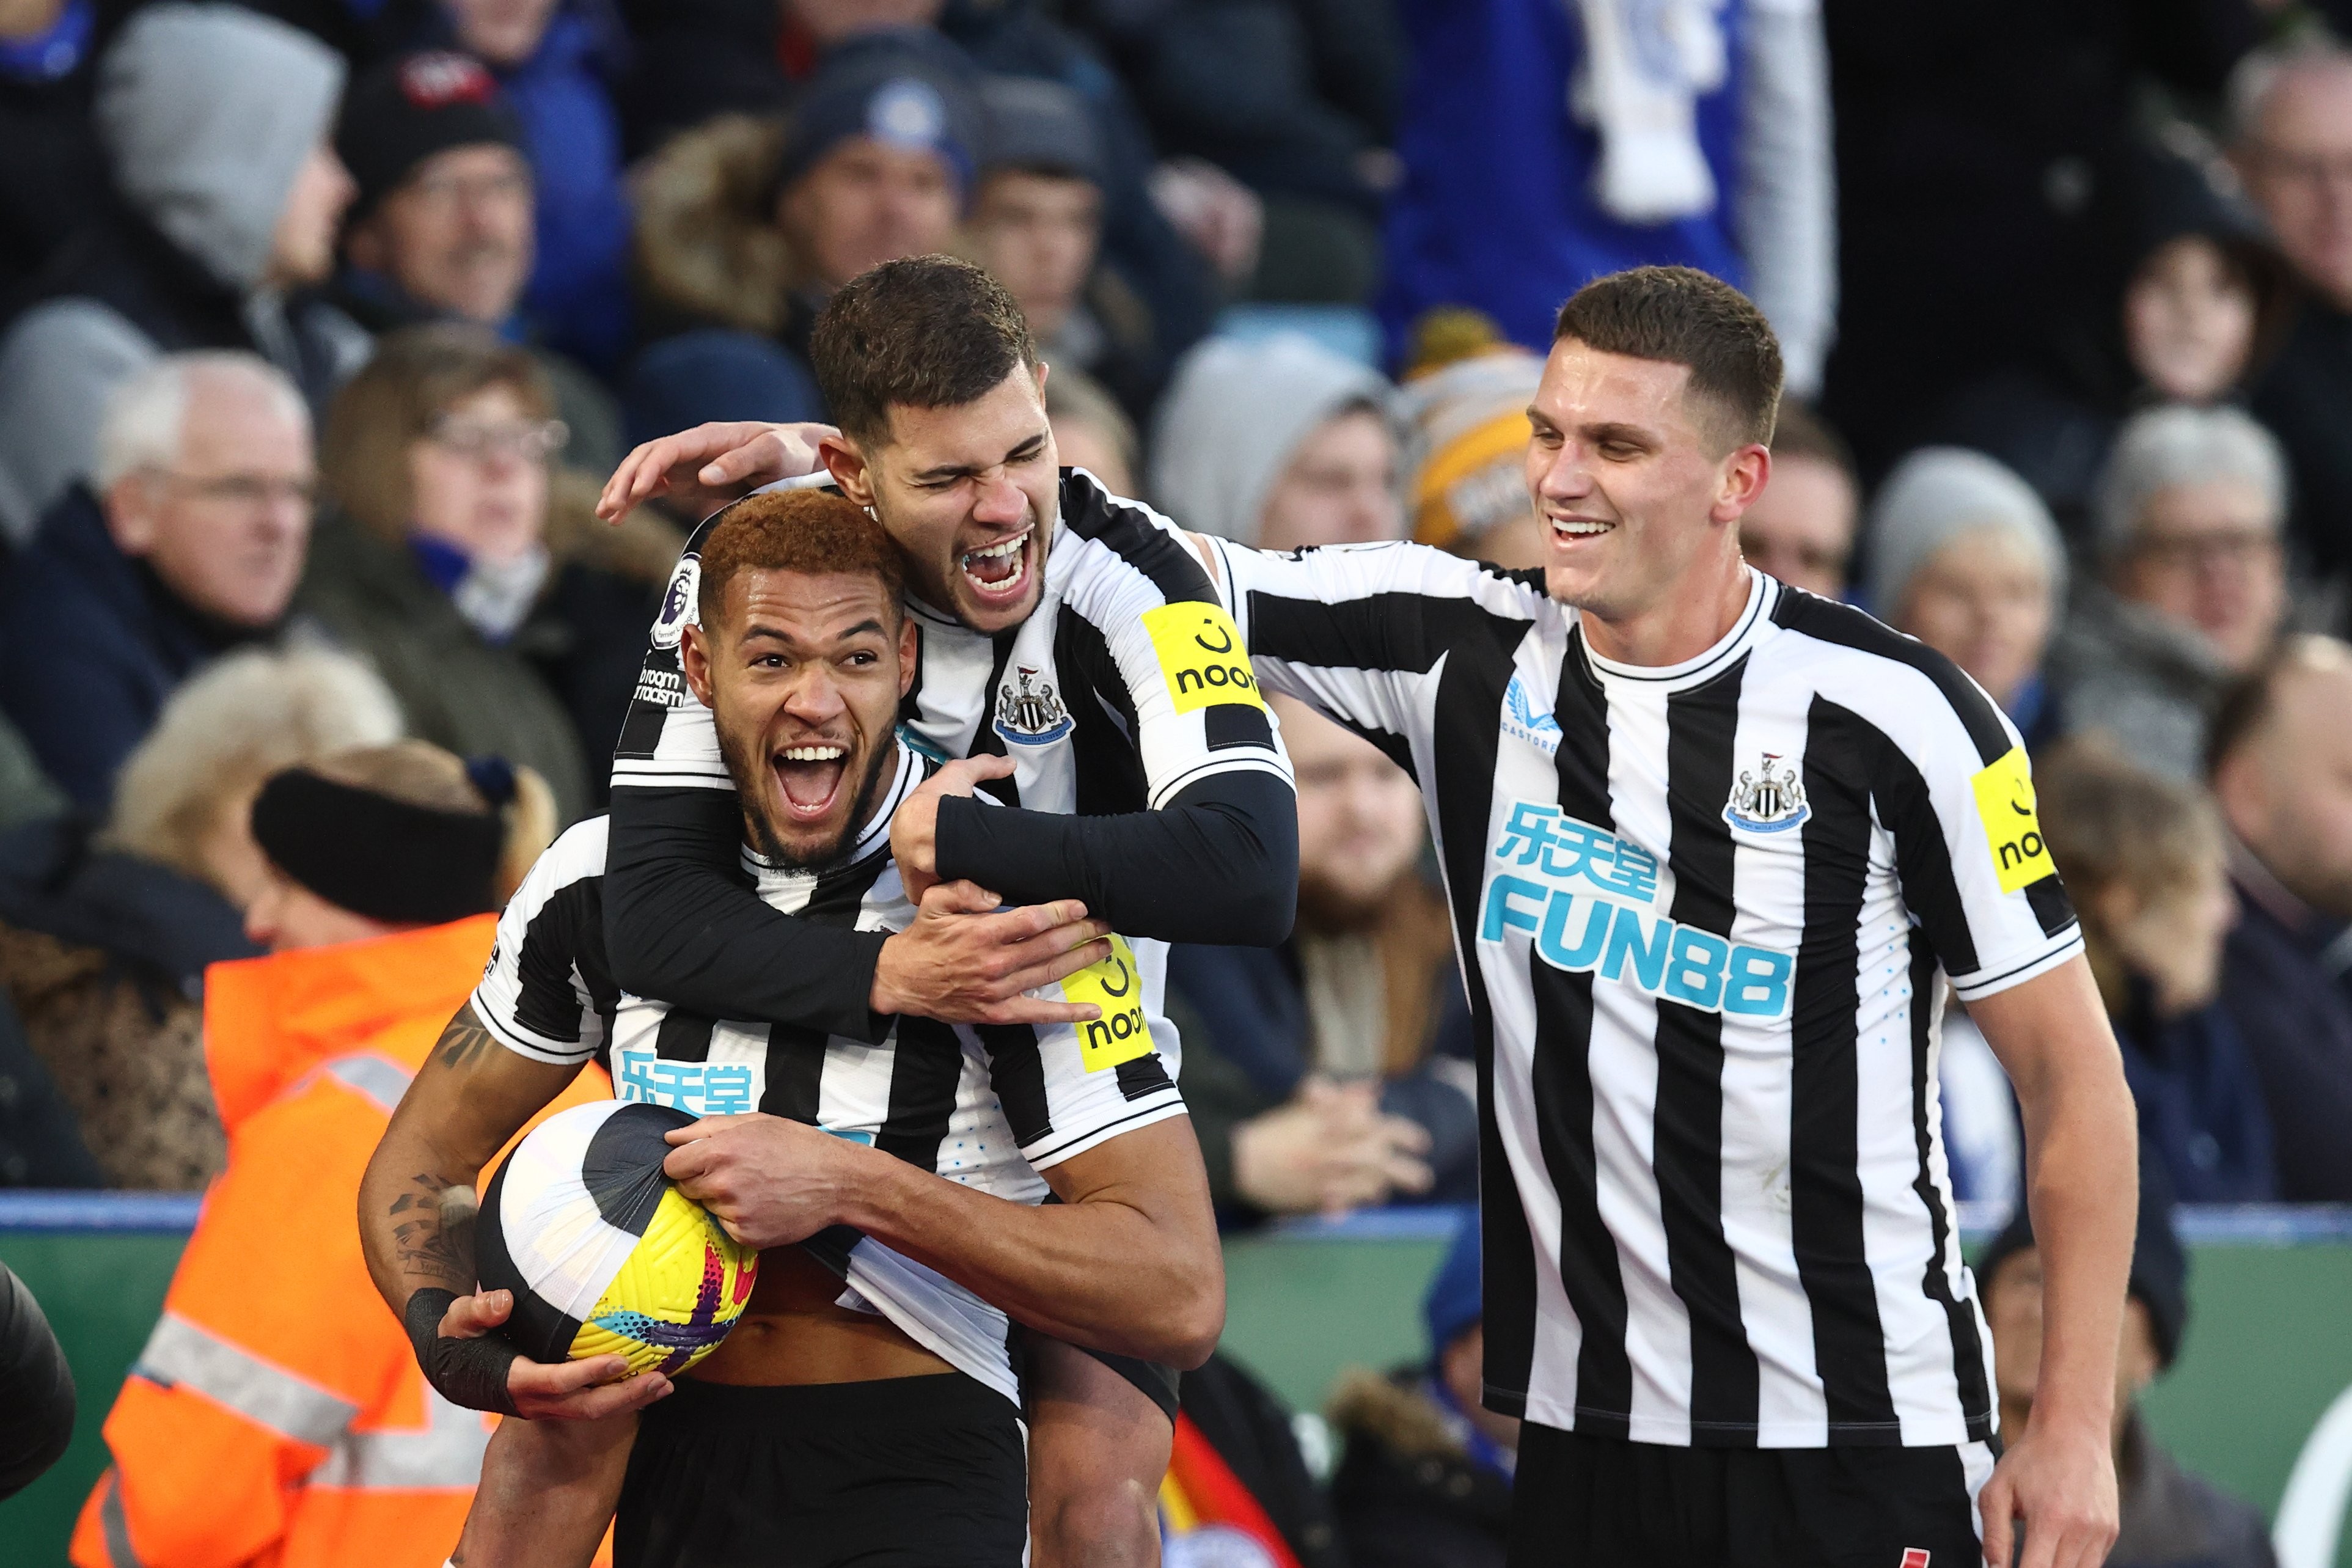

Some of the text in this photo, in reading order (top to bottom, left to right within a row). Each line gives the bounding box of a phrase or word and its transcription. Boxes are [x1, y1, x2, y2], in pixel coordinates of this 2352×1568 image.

[676, 607, 697, 632] League
[645, 669, 680, 689] room
[639, 685, 684, 708] racism
[1501, 722, 1556, 753] CASTORE
[1496, 802, 1659, 904] 乐天堂
[1482, 874, 1793, 1016] FUN88
[622, 1050, 752, 1118] 乐天堂
